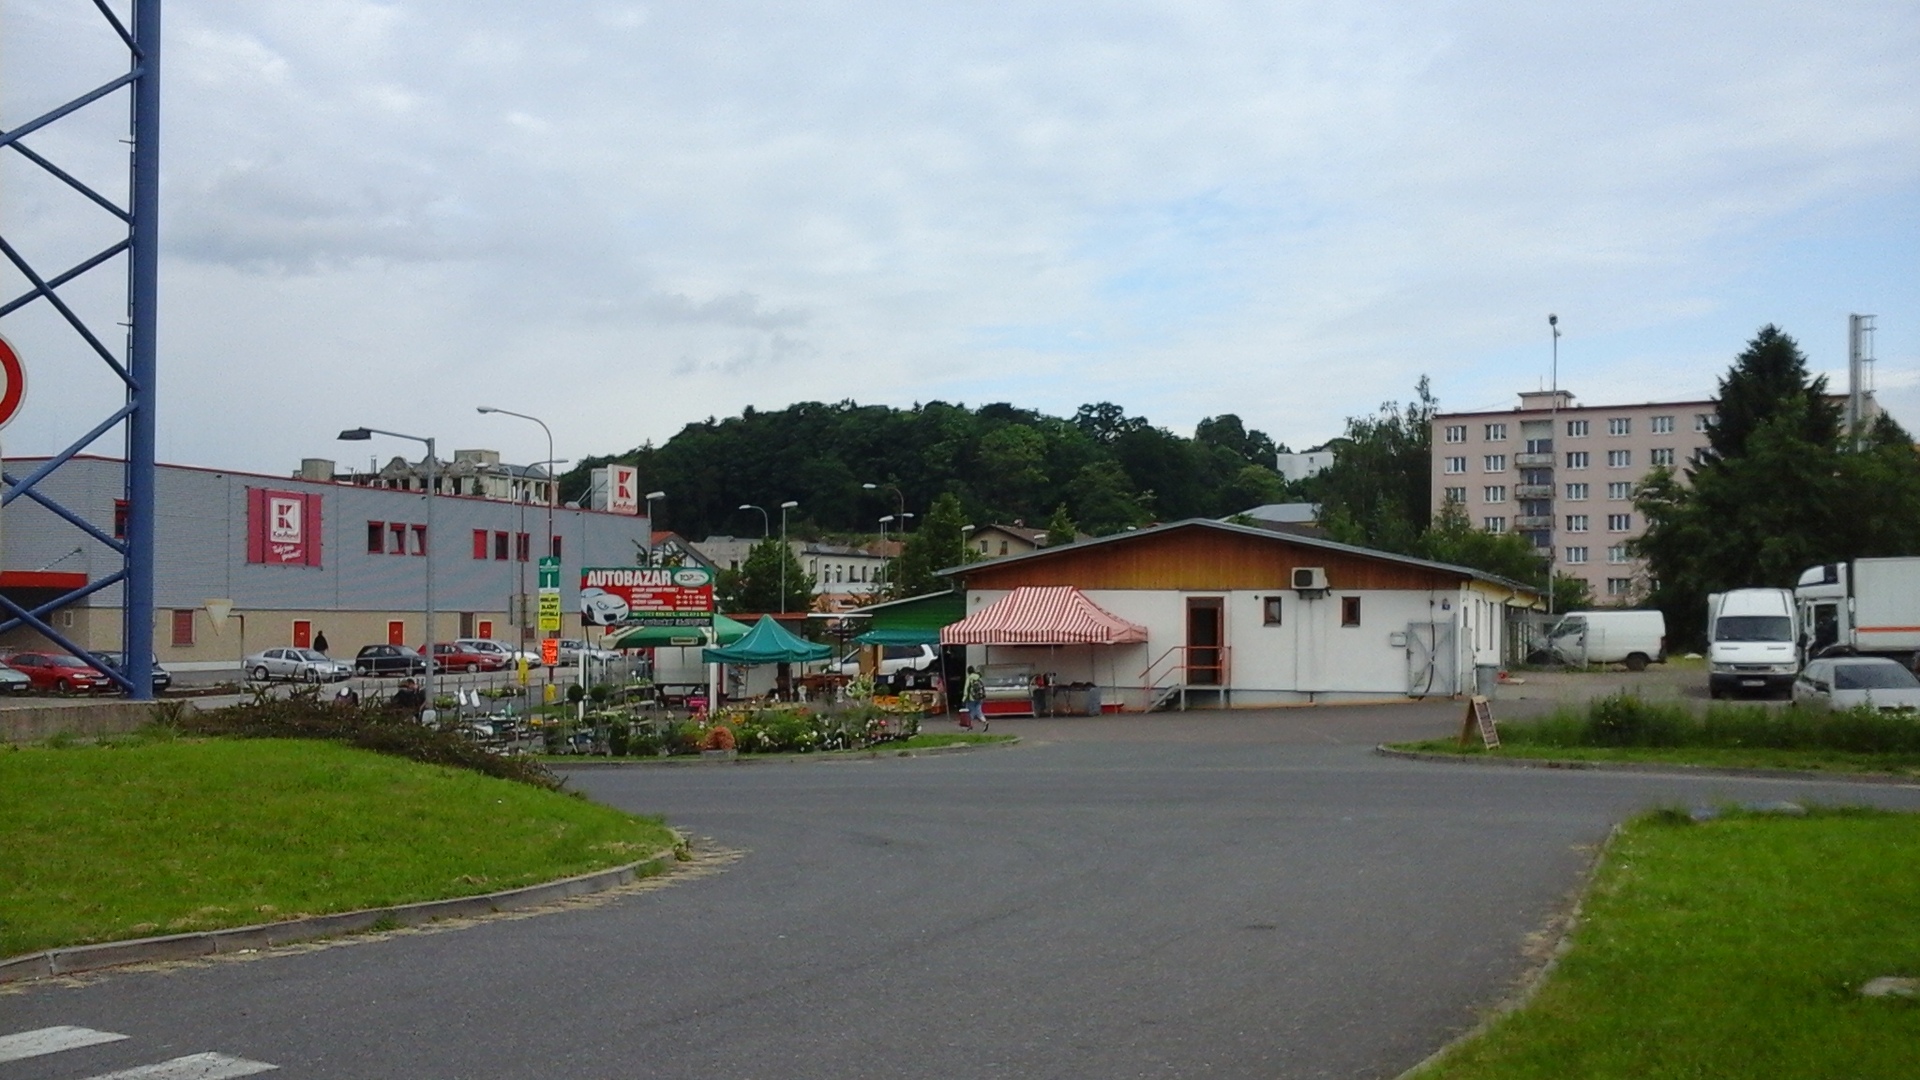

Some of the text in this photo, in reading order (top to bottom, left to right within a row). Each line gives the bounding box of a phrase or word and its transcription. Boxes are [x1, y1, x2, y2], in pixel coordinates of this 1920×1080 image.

[618, 471, 631, 499] K
[278, 504, 293, 529] K
[587, 569, 672, 587] AUTOBAZAR
